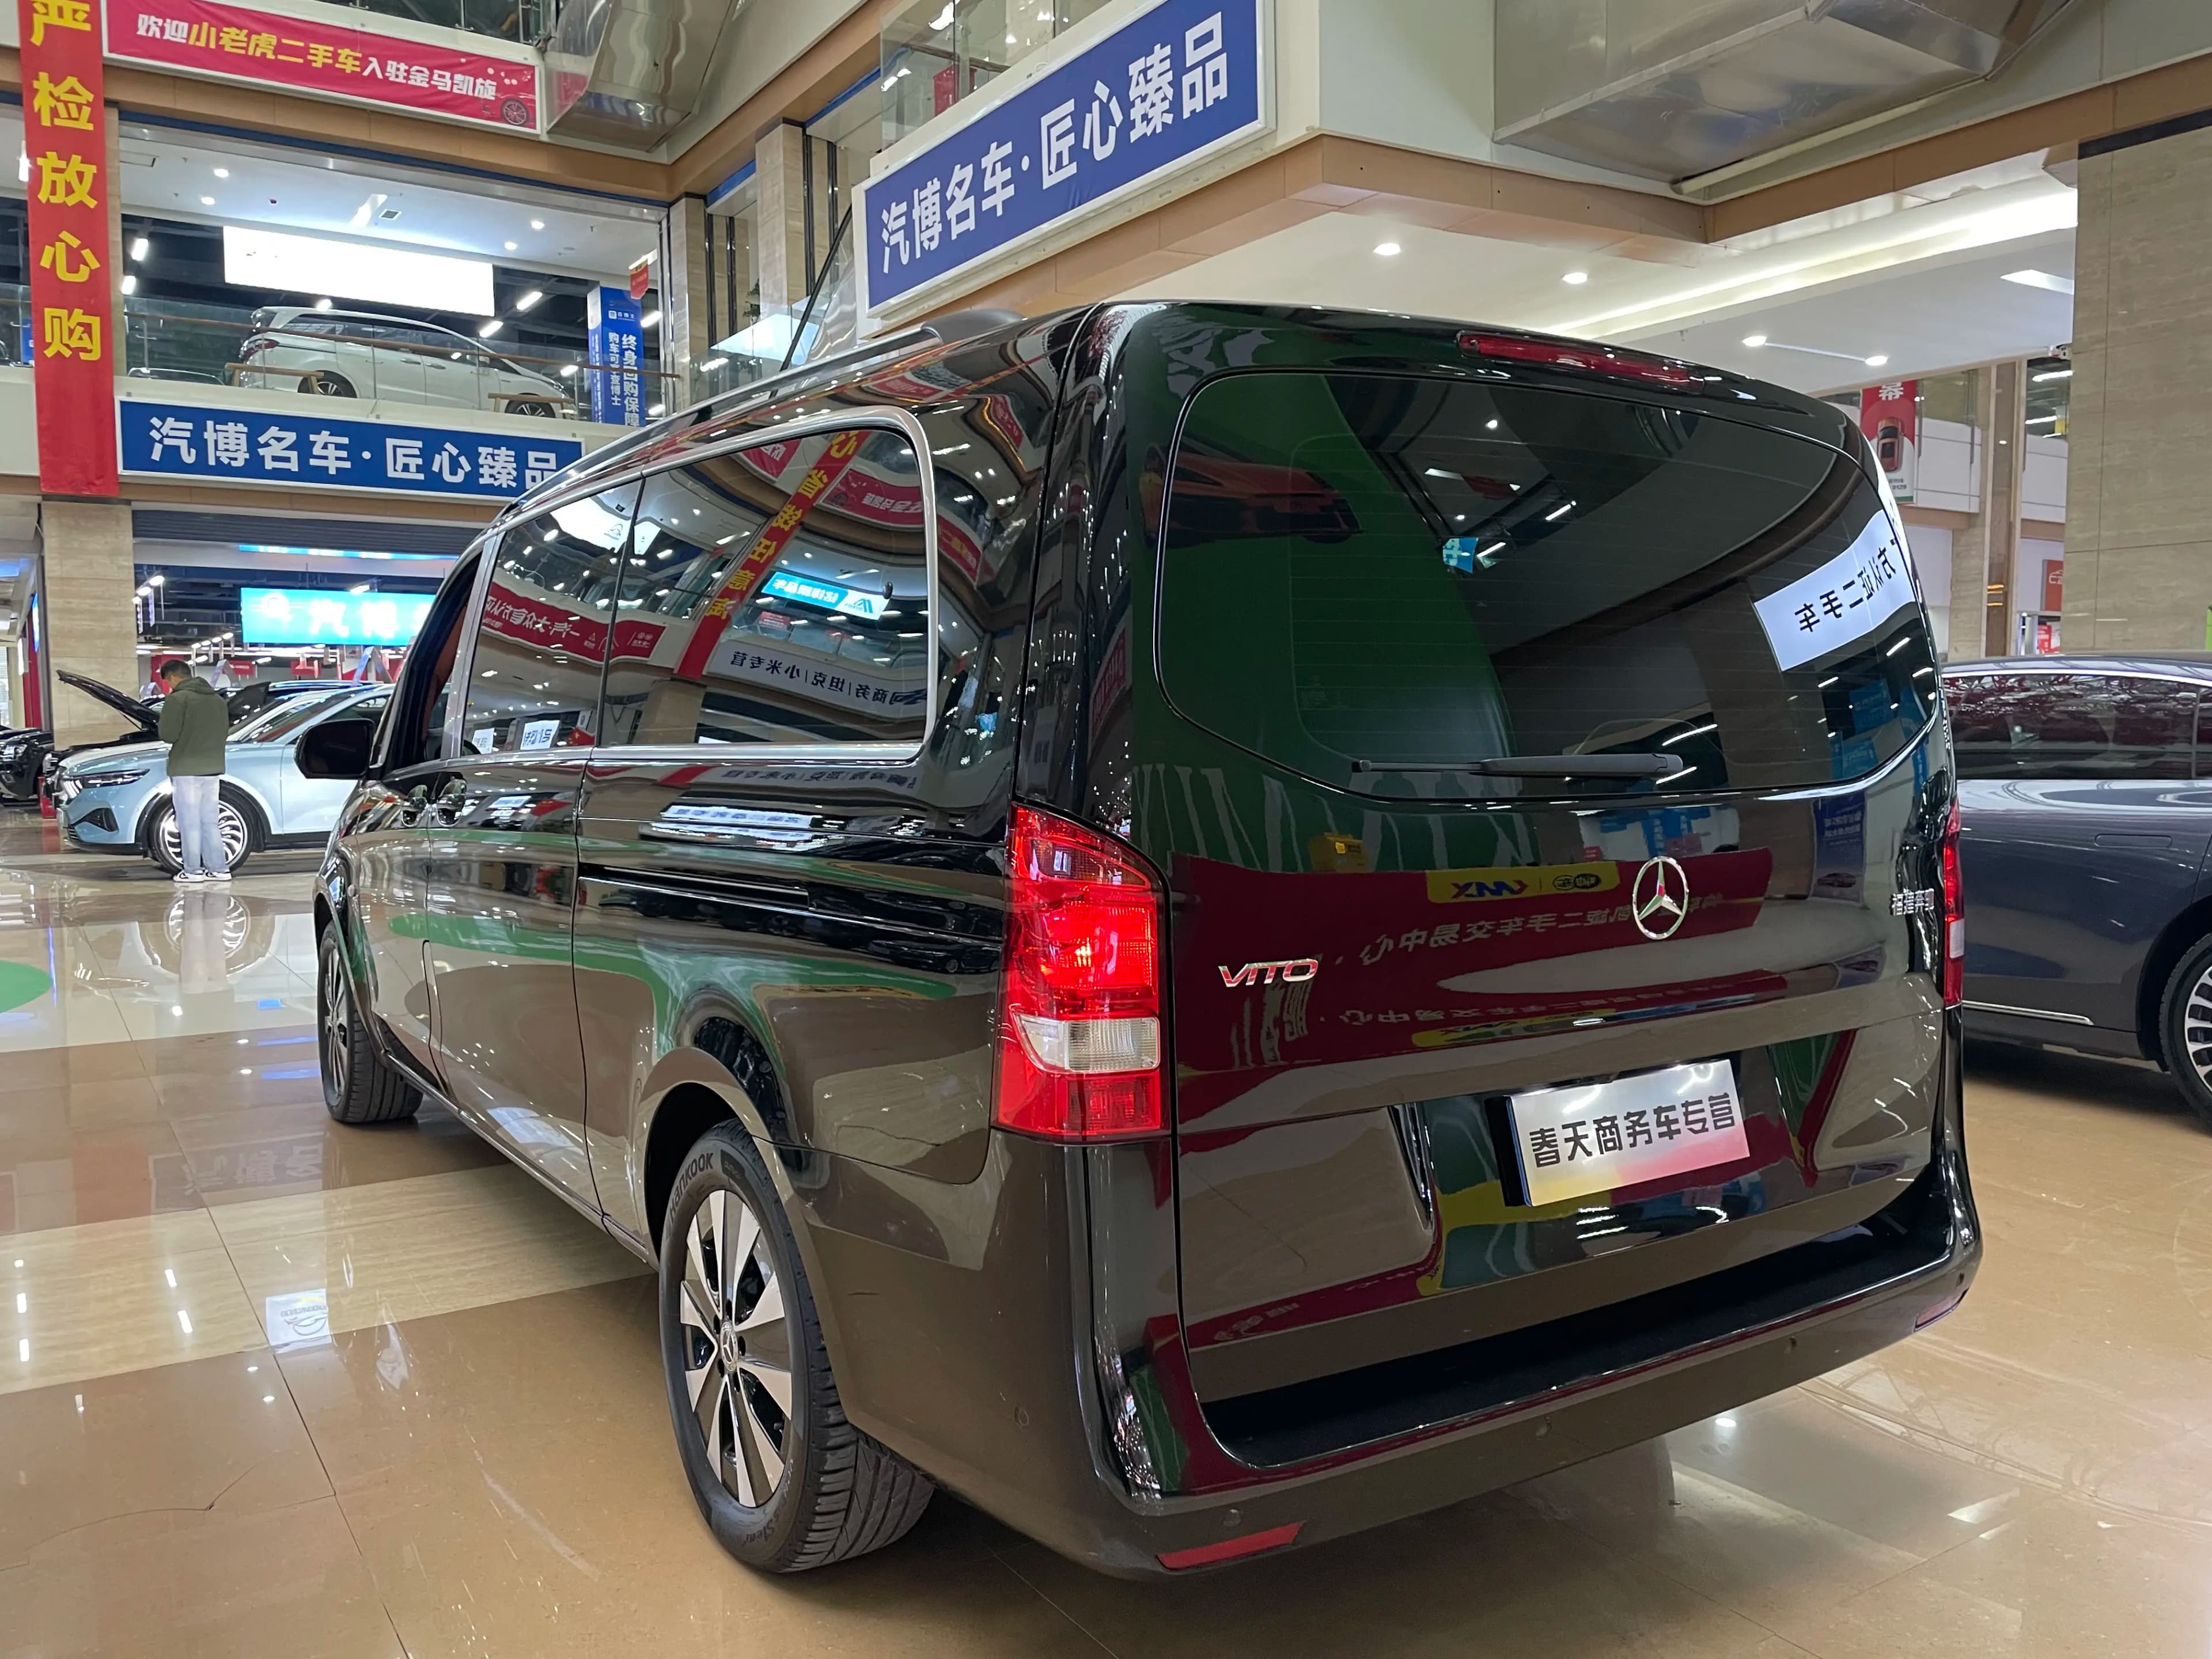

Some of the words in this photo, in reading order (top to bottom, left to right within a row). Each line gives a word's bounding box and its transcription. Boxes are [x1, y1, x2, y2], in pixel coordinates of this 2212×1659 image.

[137, 13, 497, 101] 欢迎小老虎二手车入驻金马凯旋
[880, 11, 1229, 274] 汽博名车·匠心臻品
[149, 416, 558, 491] 汽博名车·匠心臻品
[1218, 957, 1320, 987] VITO
[1529, 1092, 1736, 1168] 春天商务车专营
